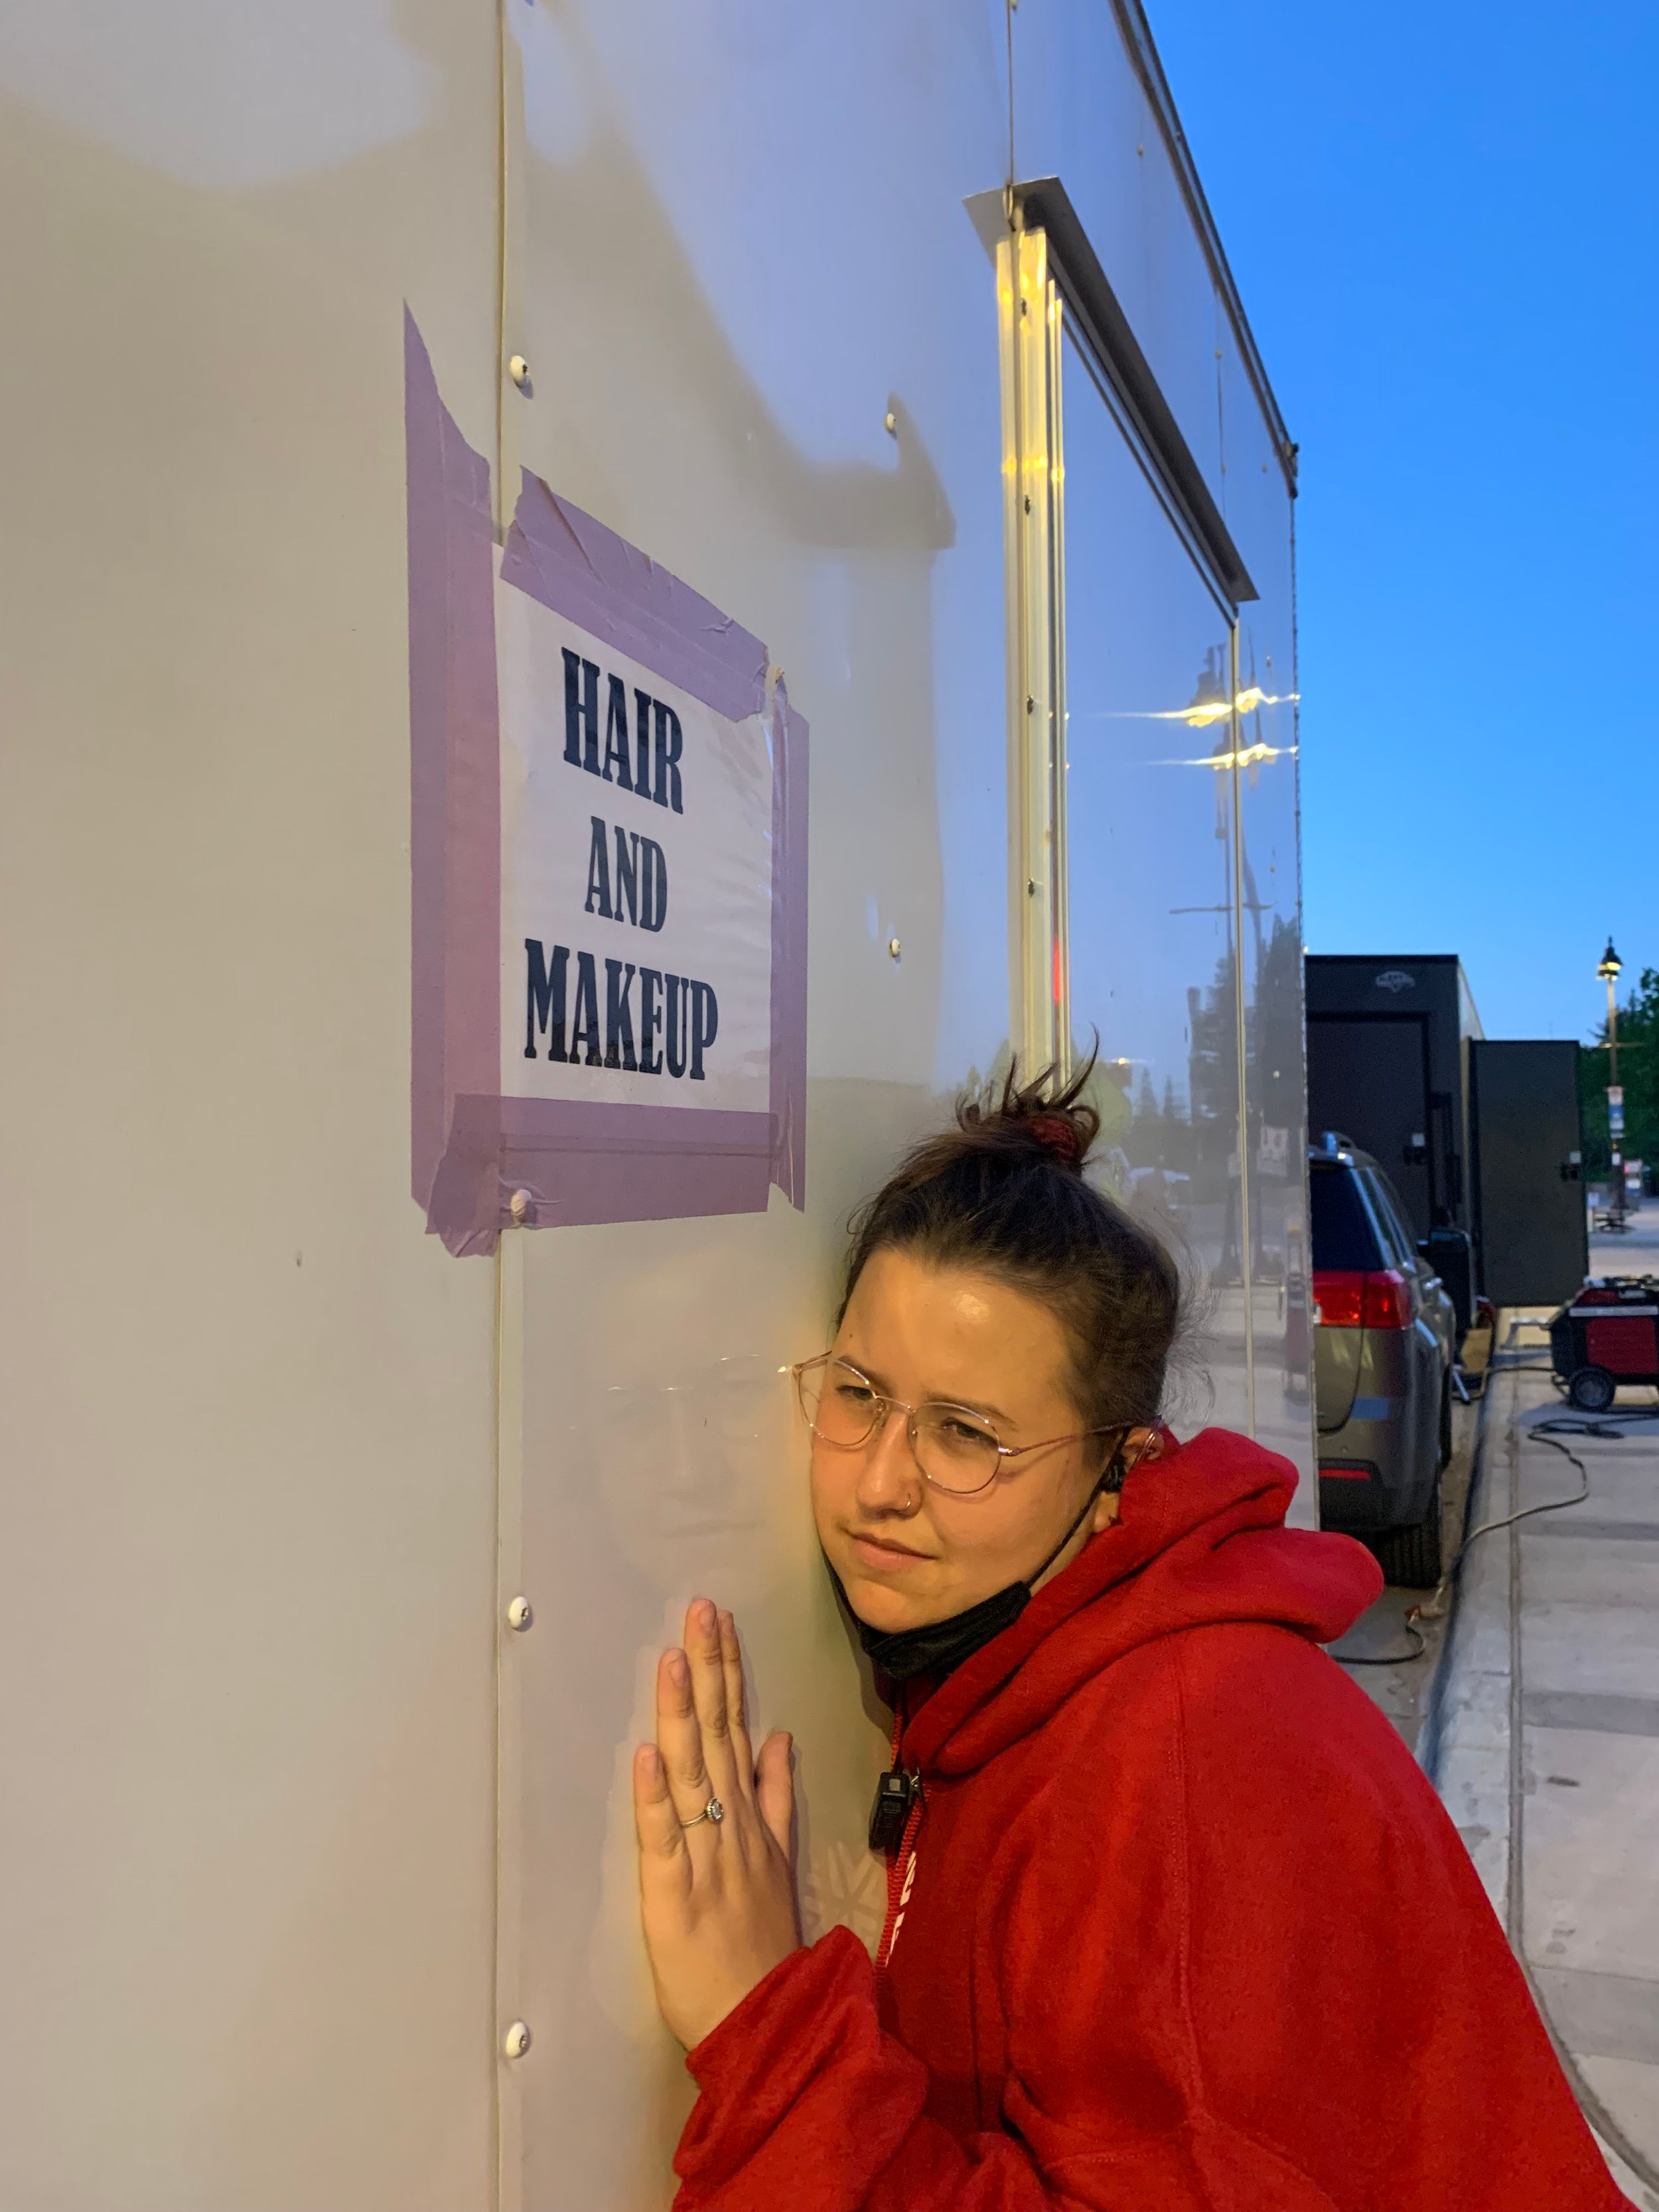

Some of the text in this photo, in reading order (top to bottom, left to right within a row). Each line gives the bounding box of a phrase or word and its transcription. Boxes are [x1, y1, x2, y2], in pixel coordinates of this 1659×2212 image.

[561, 646, 684, 815] HAIR
[585, 816, 668, 932] AND
[524, 938, 718, 1081] MAKEUP
